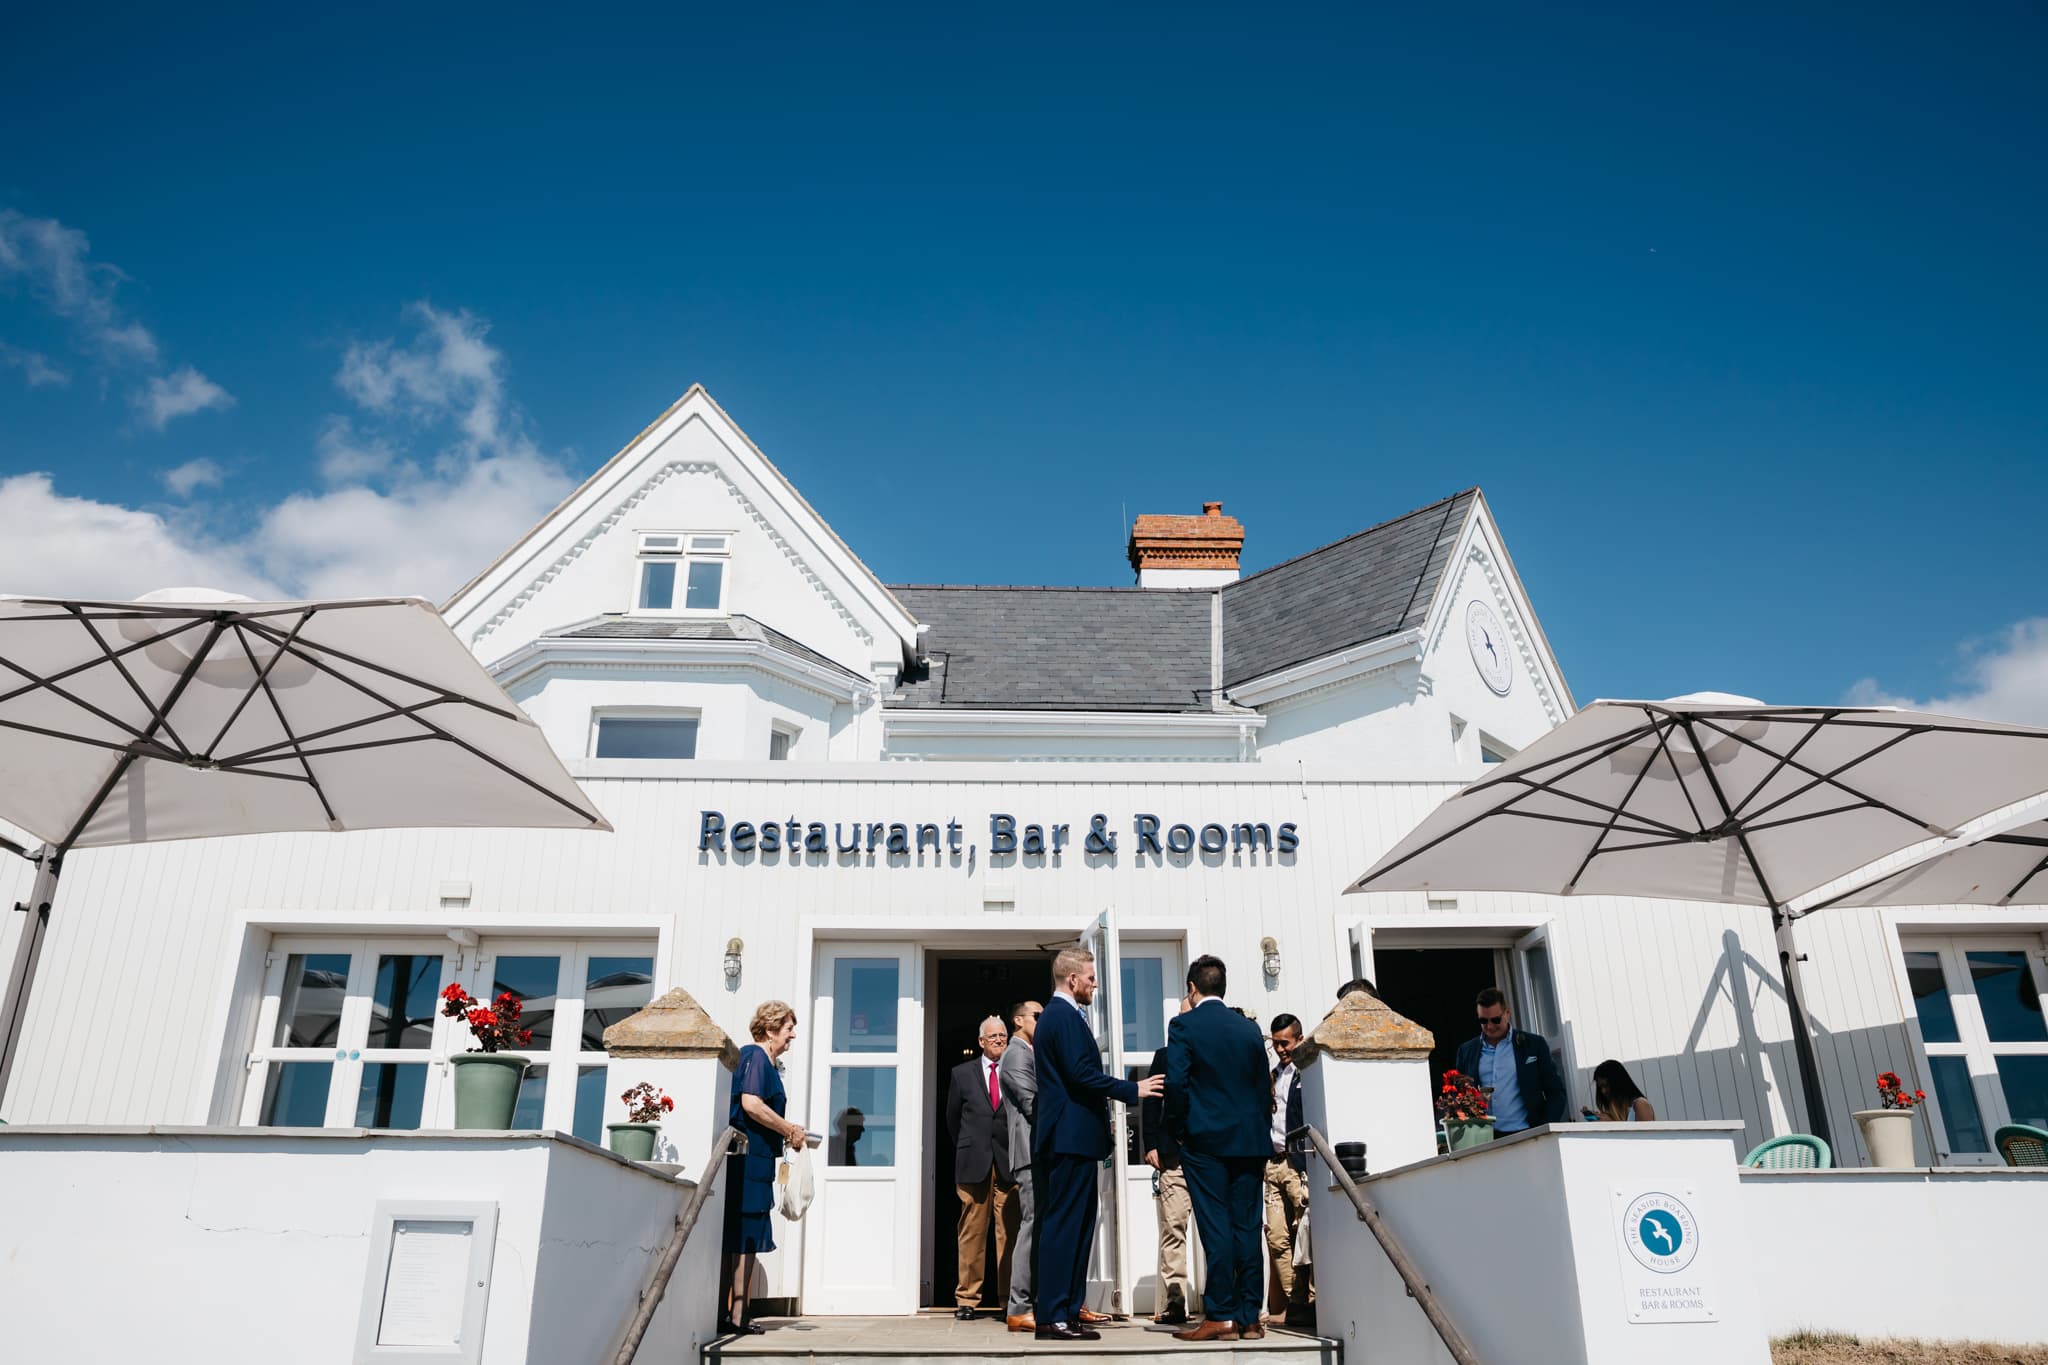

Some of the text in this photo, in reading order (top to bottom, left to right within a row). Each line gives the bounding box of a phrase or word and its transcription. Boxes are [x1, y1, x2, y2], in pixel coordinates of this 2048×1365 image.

[698, 810, 1300, 863] Restaurant, Bar & Rooms
[1630, 1199, 1692, 1244] THE SEASIDE BOARDING
[1650, 1255, 1681, 1266] HOUSE
[1639, 1287, 1702, 1298] RESTAURANT
[1641, 1299, 1704, 1310] BAR & ROOMS
